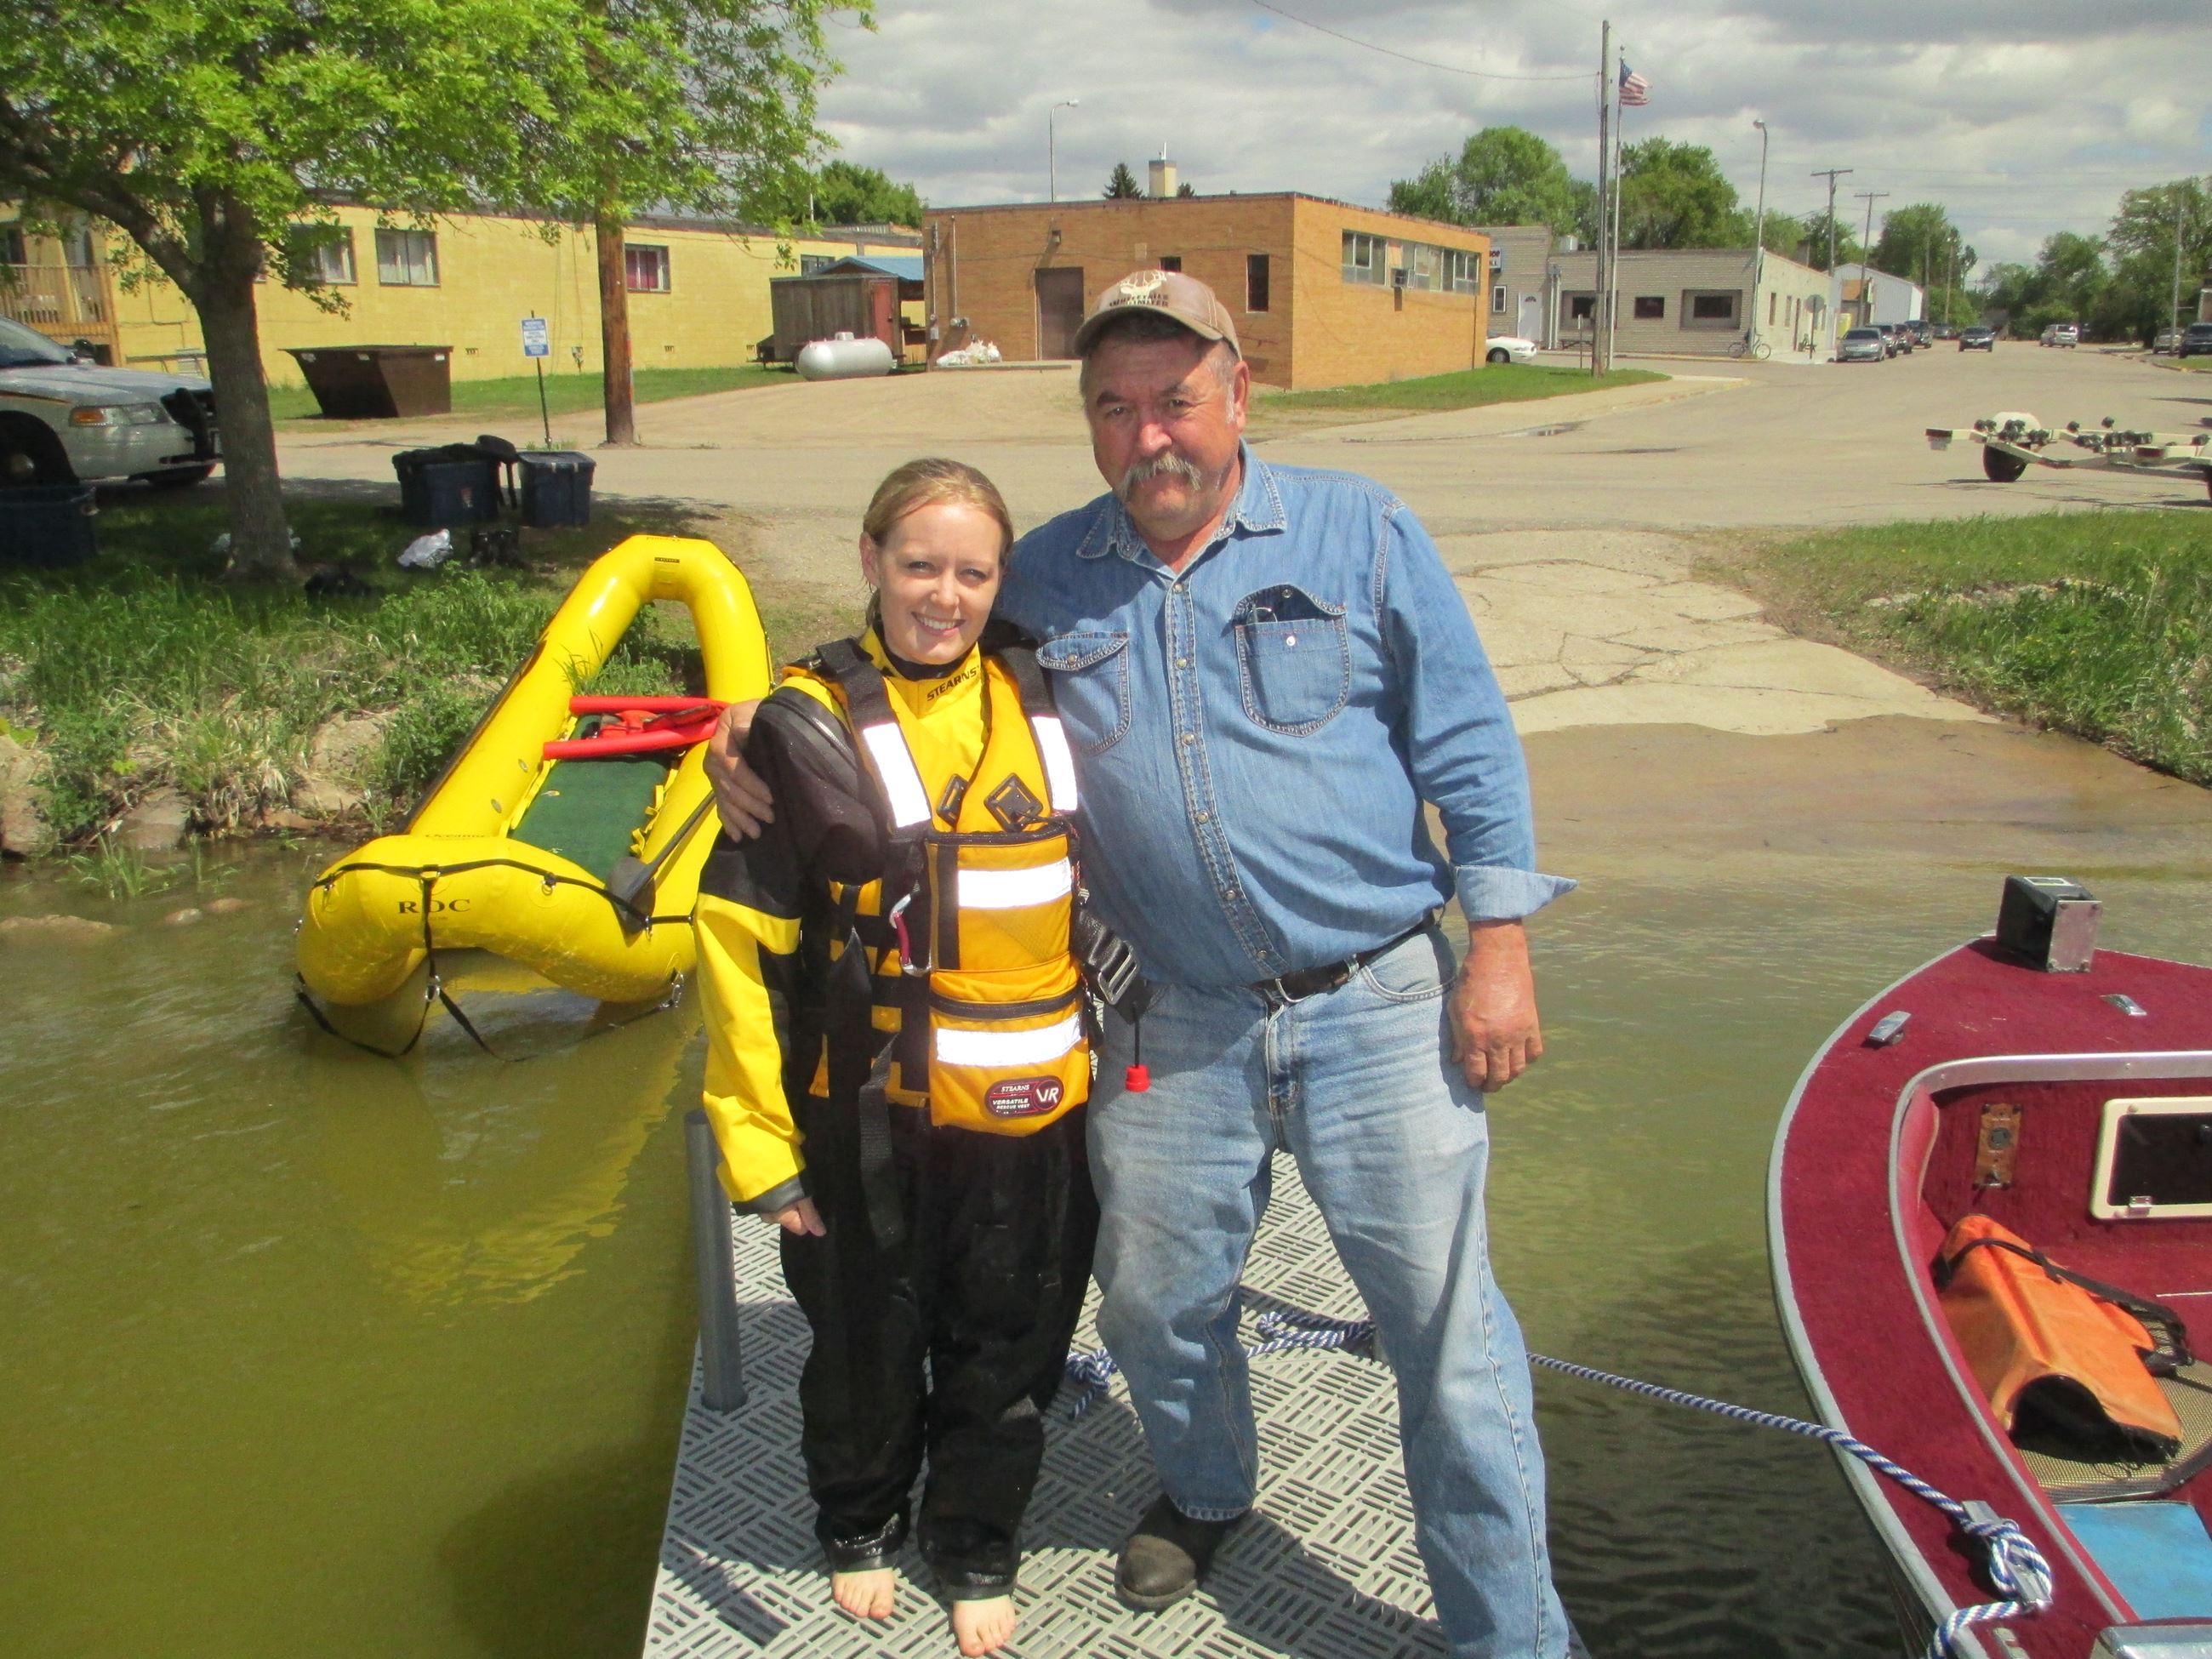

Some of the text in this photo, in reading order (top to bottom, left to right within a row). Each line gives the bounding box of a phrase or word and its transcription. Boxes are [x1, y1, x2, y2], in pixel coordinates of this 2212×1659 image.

[926, 667, 977, 701] STEARNS
[397, 899, 470, 914] RDC
[1036, 1087, 1059, 1103] VR
